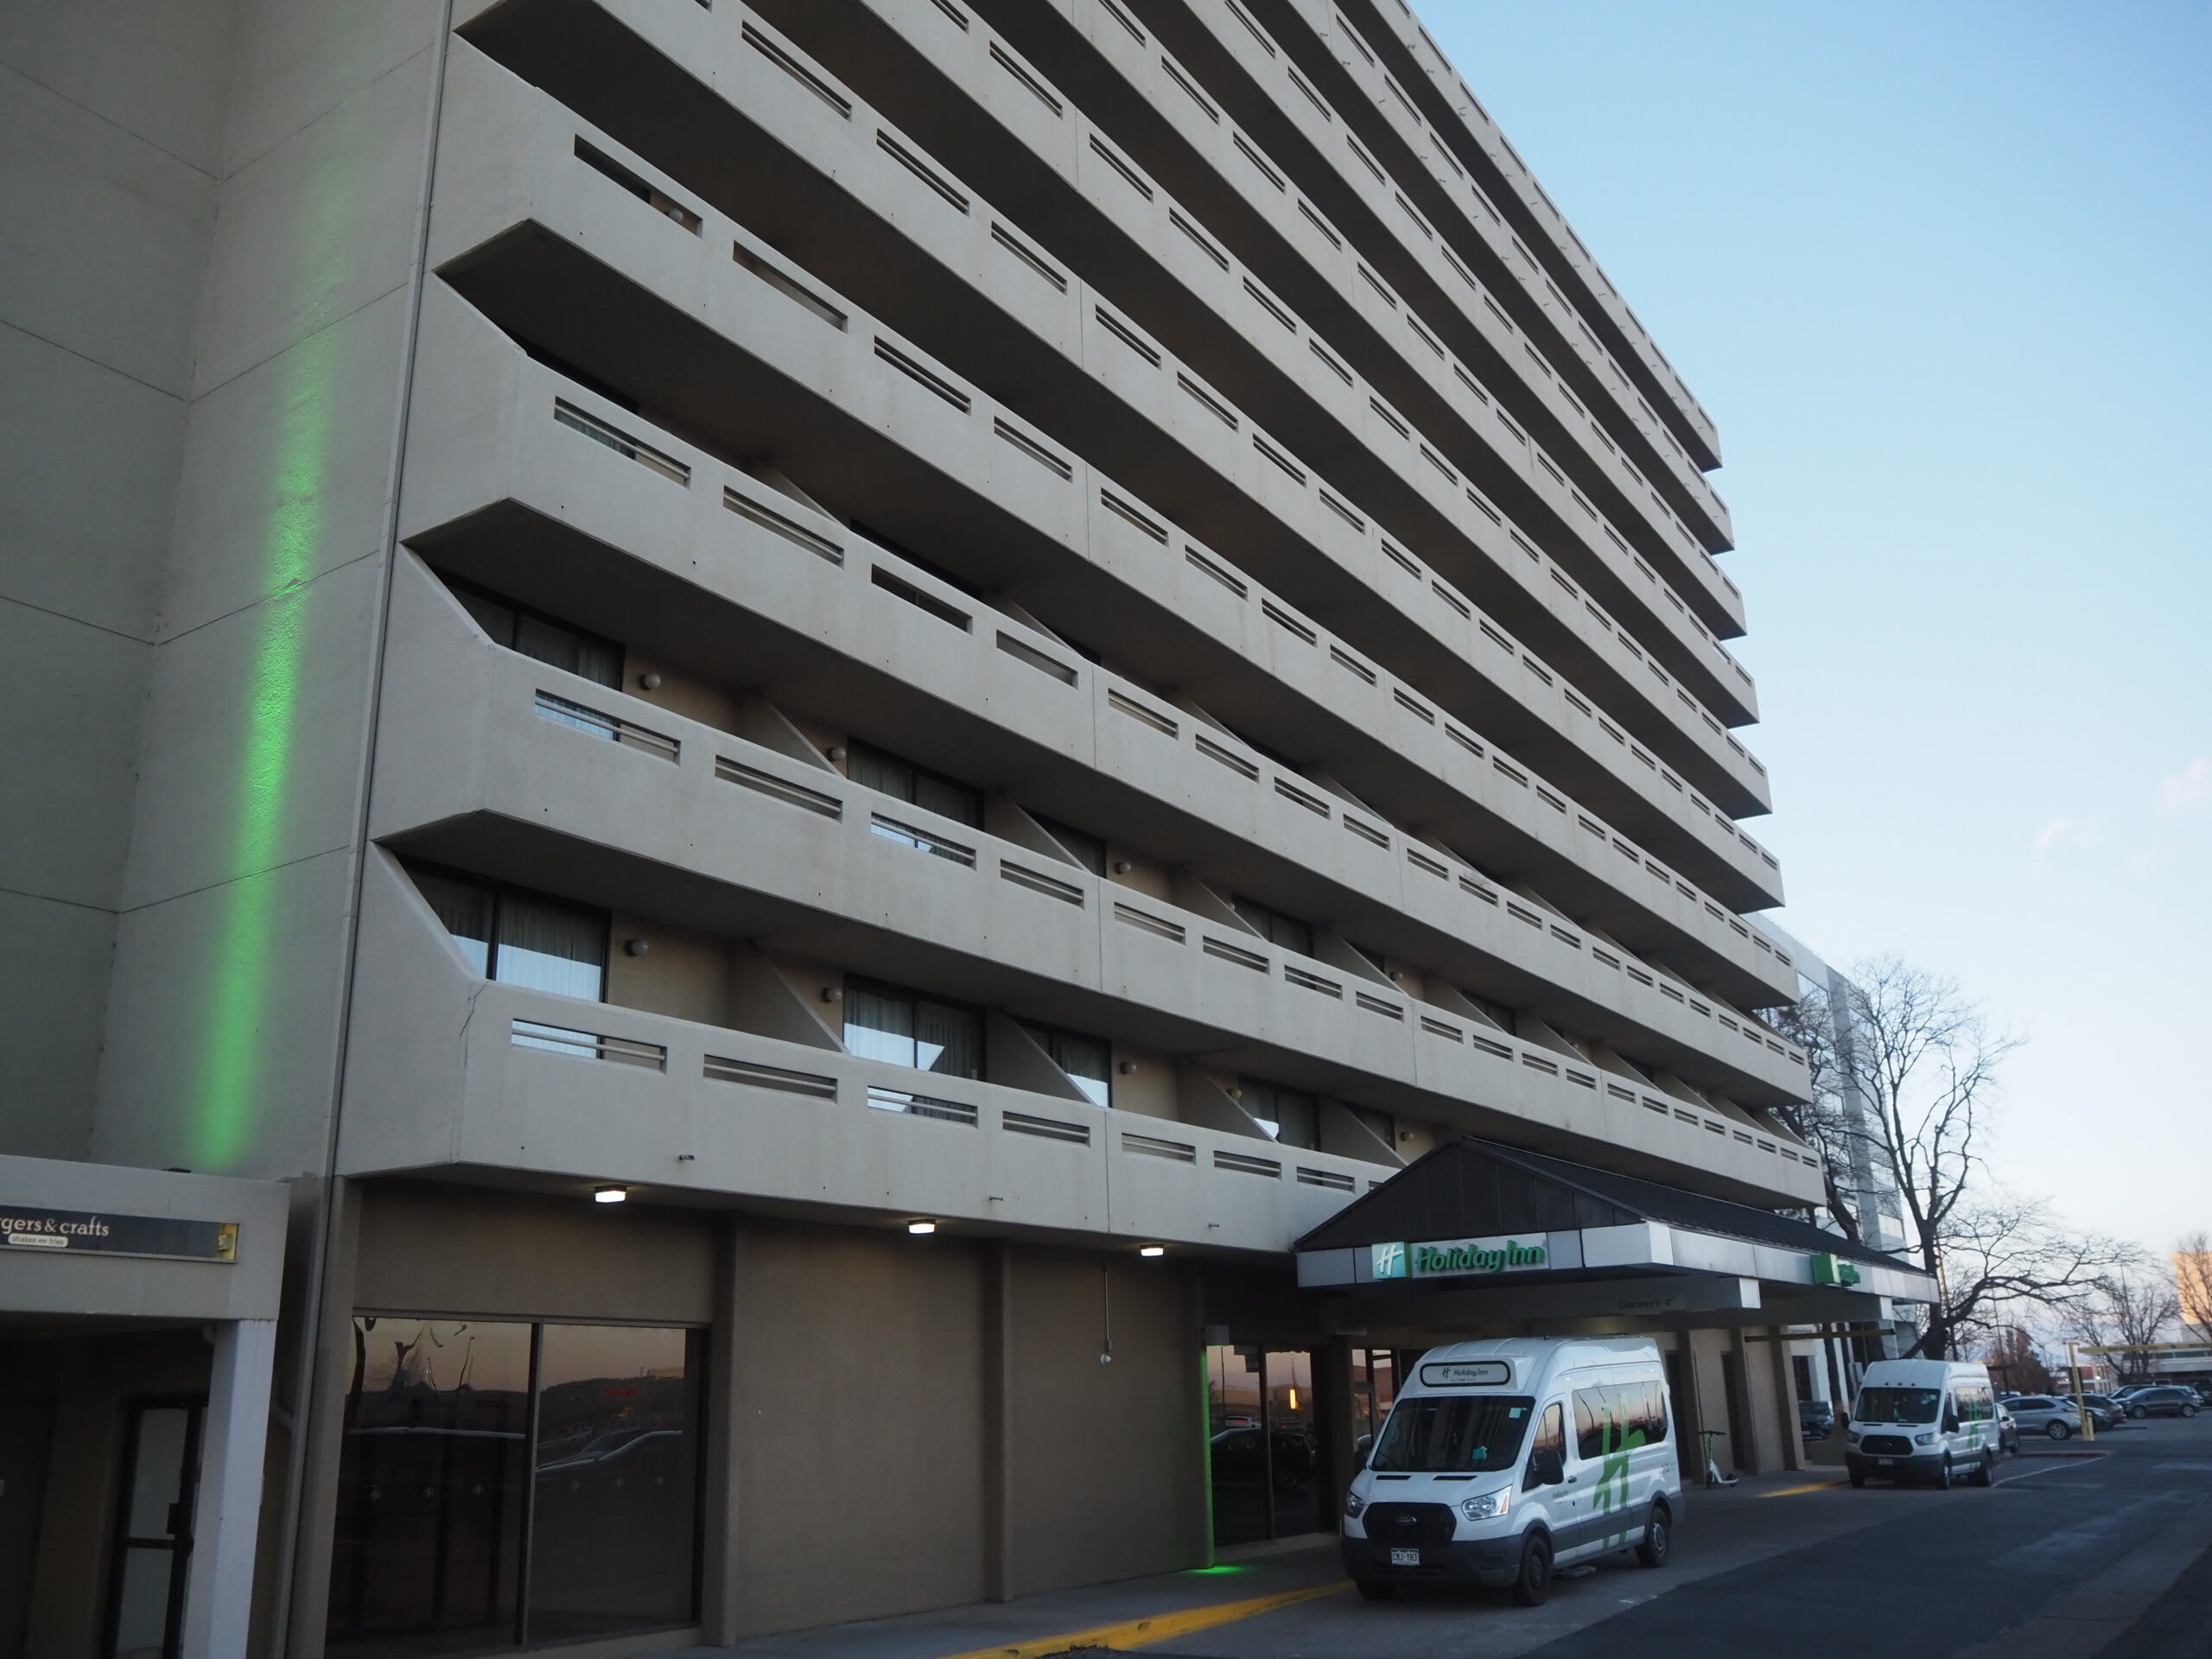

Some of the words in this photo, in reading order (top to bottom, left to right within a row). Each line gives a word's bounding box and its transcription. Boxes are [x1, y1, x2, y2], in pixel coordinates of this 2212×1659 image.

[0, 1217, 42, 1235] gers
[44, 1217, 57, 1233] &
[59, 1215, 110, 1236] crafts
[48, 1237, 65, 1246] fries
[1414, 1243, 1505, 1273] Holiday
[1506, 1239, 1546, 1266] Inn
[1618, 1299, 1654, 1310] Clearance
[1453, 1368, 1478, 1377] Holiday
